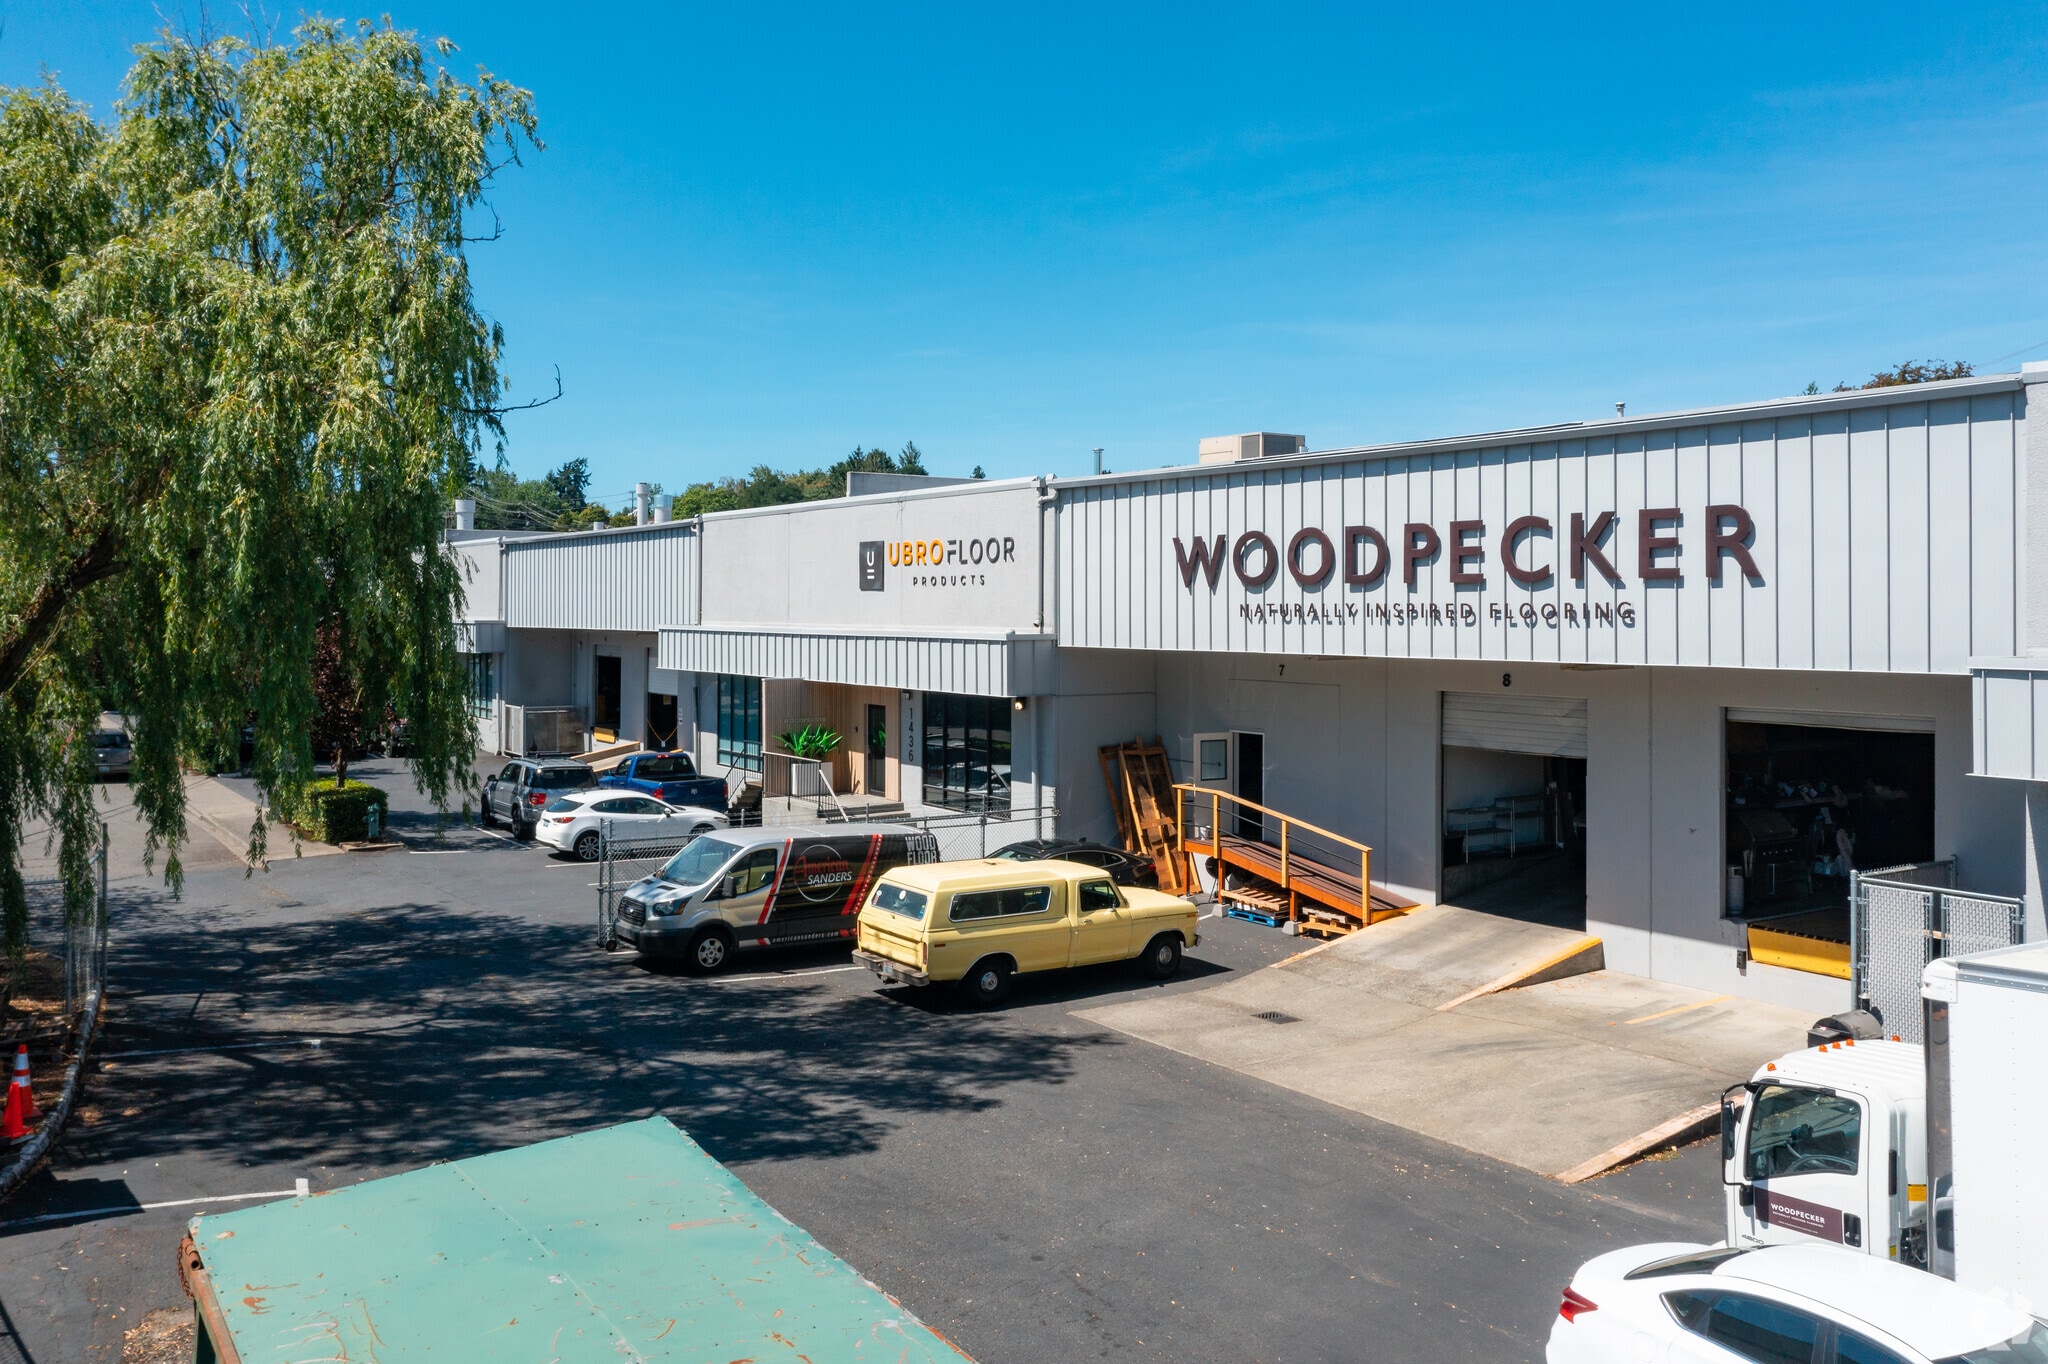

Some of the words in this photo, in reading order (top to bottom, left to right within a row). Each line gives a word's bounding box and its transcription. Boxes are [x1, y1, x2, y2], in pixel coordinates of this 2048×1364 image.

[888, 537, 1015, 566] UBROFLOOR
[1172, 504, 1762, 589] WOODPECKER
[913, 575, 985, 587] PRODUCTS
[1240, 603, 1356, 618] NATURALLY
[1366, 603, 1474, 619] INSPIRED
[1489, 601, 1633, 620] FLOORING
[1278, 664, 1285, 676] 7
[1502, 673, 1512, 687] 8
[904, 835, 936, 852] WOOD
[906, 850, 938, 866] FLOOR
[793, 855, 849, 885] American
[808, 871, 852, 885] SANDERS
[772, 931, 839, 943] americansanders.com
[1770, 1203, 1826, 1224] WOODPECKER
